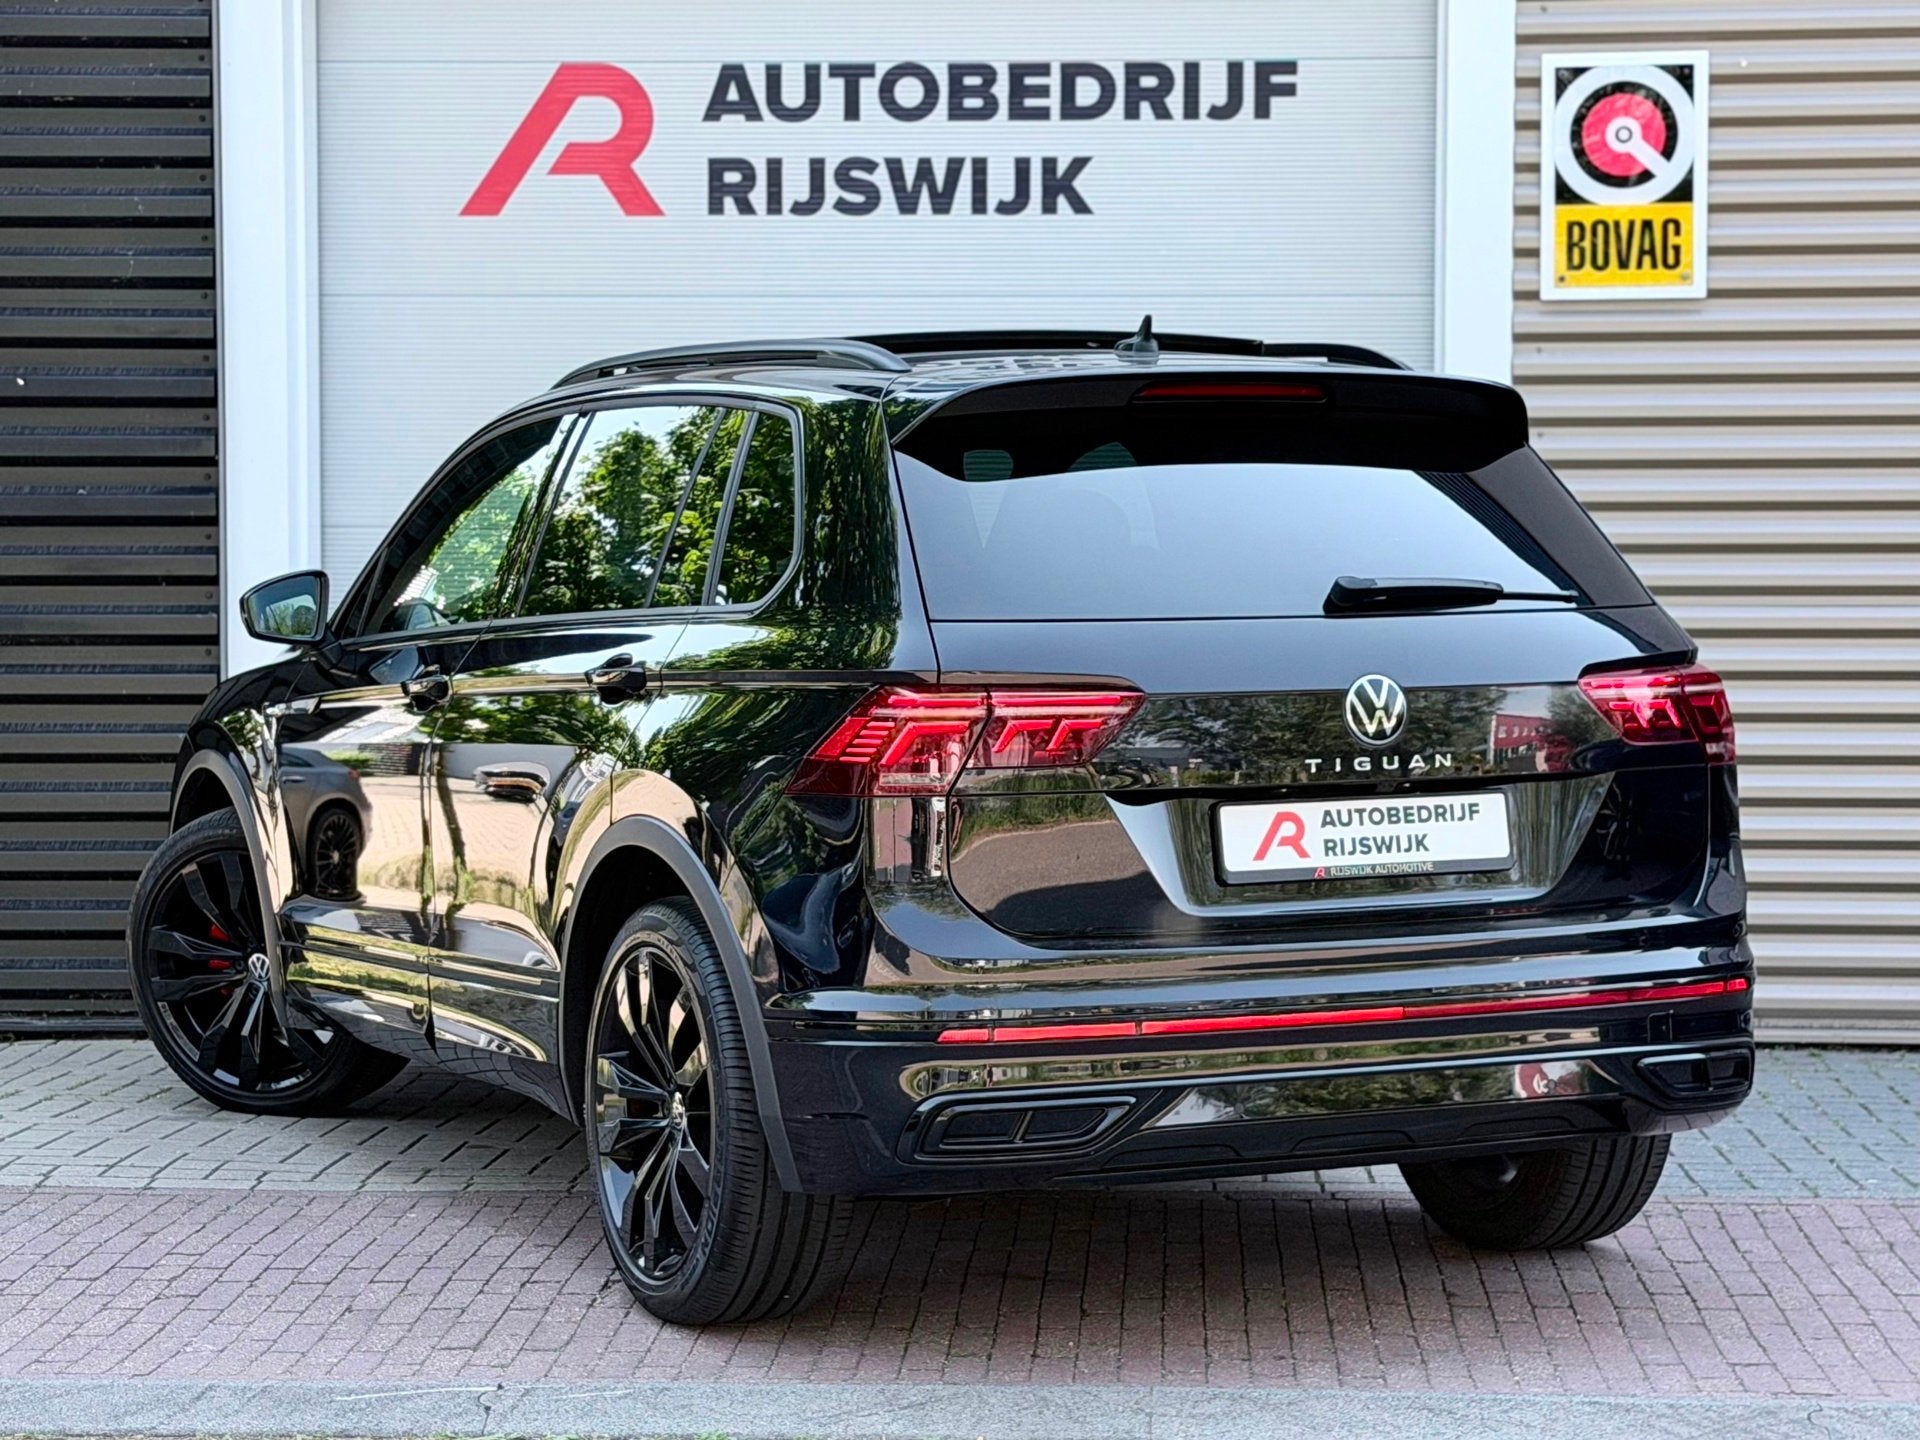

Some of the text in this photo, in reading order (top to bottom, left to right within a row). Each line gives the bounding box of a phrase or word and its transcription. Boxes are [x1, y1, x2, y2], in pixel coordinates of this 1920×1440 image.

[703, 61, 1297, 122] AUTOBEDRIJF
[708, 157, 1092, 216] RIJSWIJK
[1567, 218, 1681, 271] BOVAG
[1304, 753, 1452, 774] TIGUAN
[1320, 802, 1481, 828] AUTOBEDRIJF
[1324, 834, 1430, 857] RIJSWIJK
[1330, 861, 1434, 877] RIJSWIJK AUTOMOTIVE
